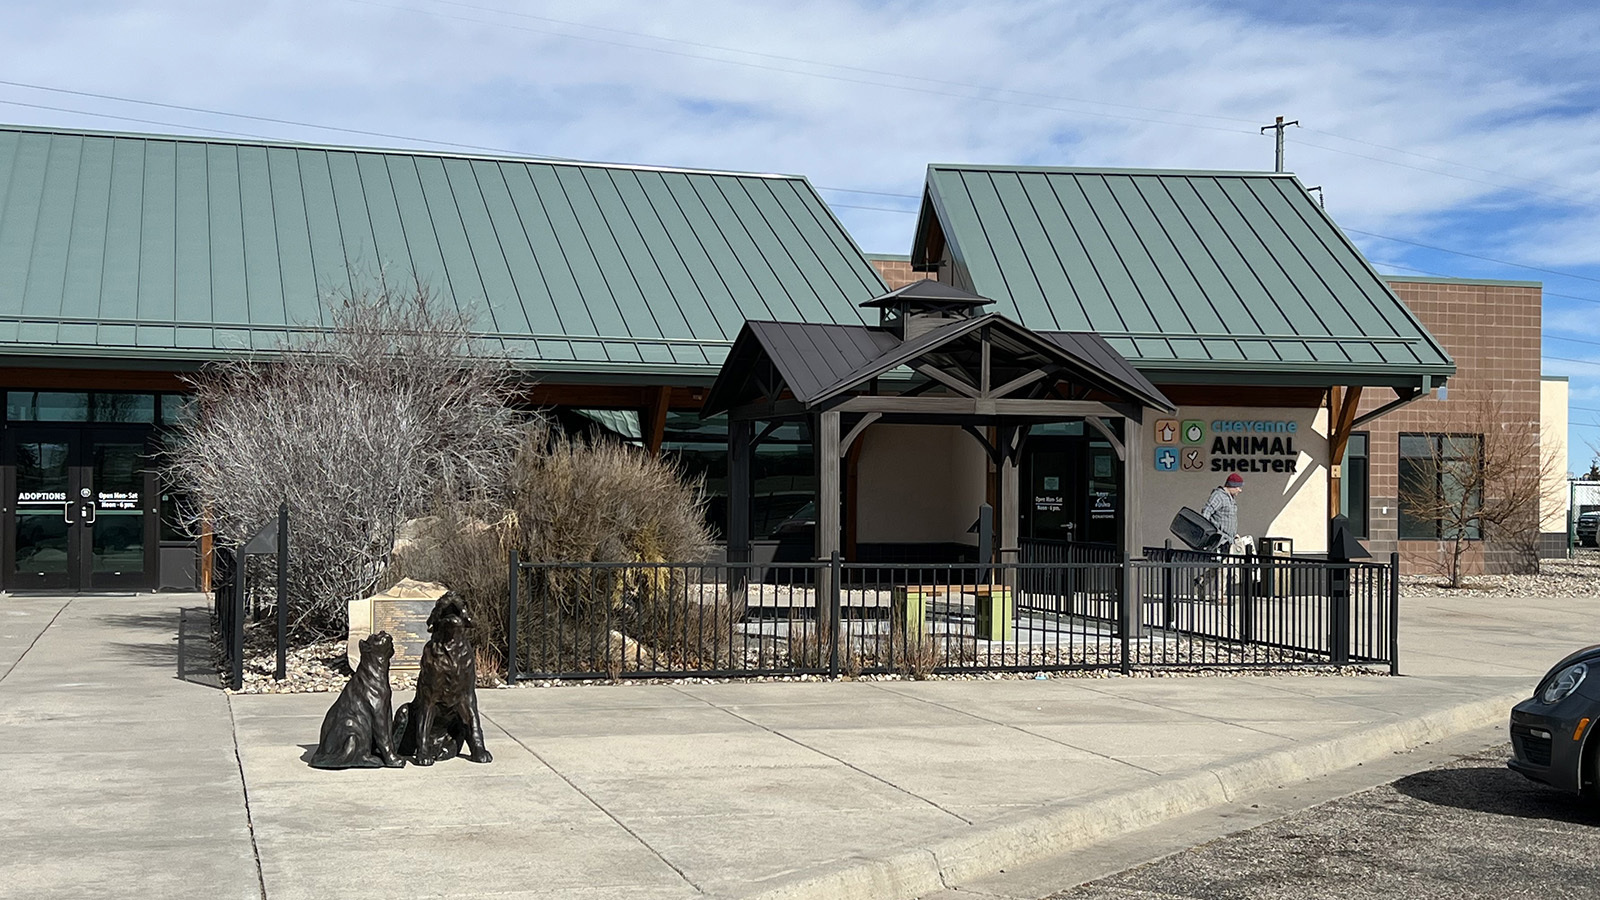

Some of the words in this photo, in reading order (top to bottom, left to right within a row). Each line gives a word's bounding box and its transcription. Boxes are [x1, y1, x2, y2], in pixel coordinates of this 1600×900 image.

[1211, 436, 1298, 455] ANIMAL
[18, 492, 67, 500] ADOPTIONS
[98, 492, 113, 500] Open
